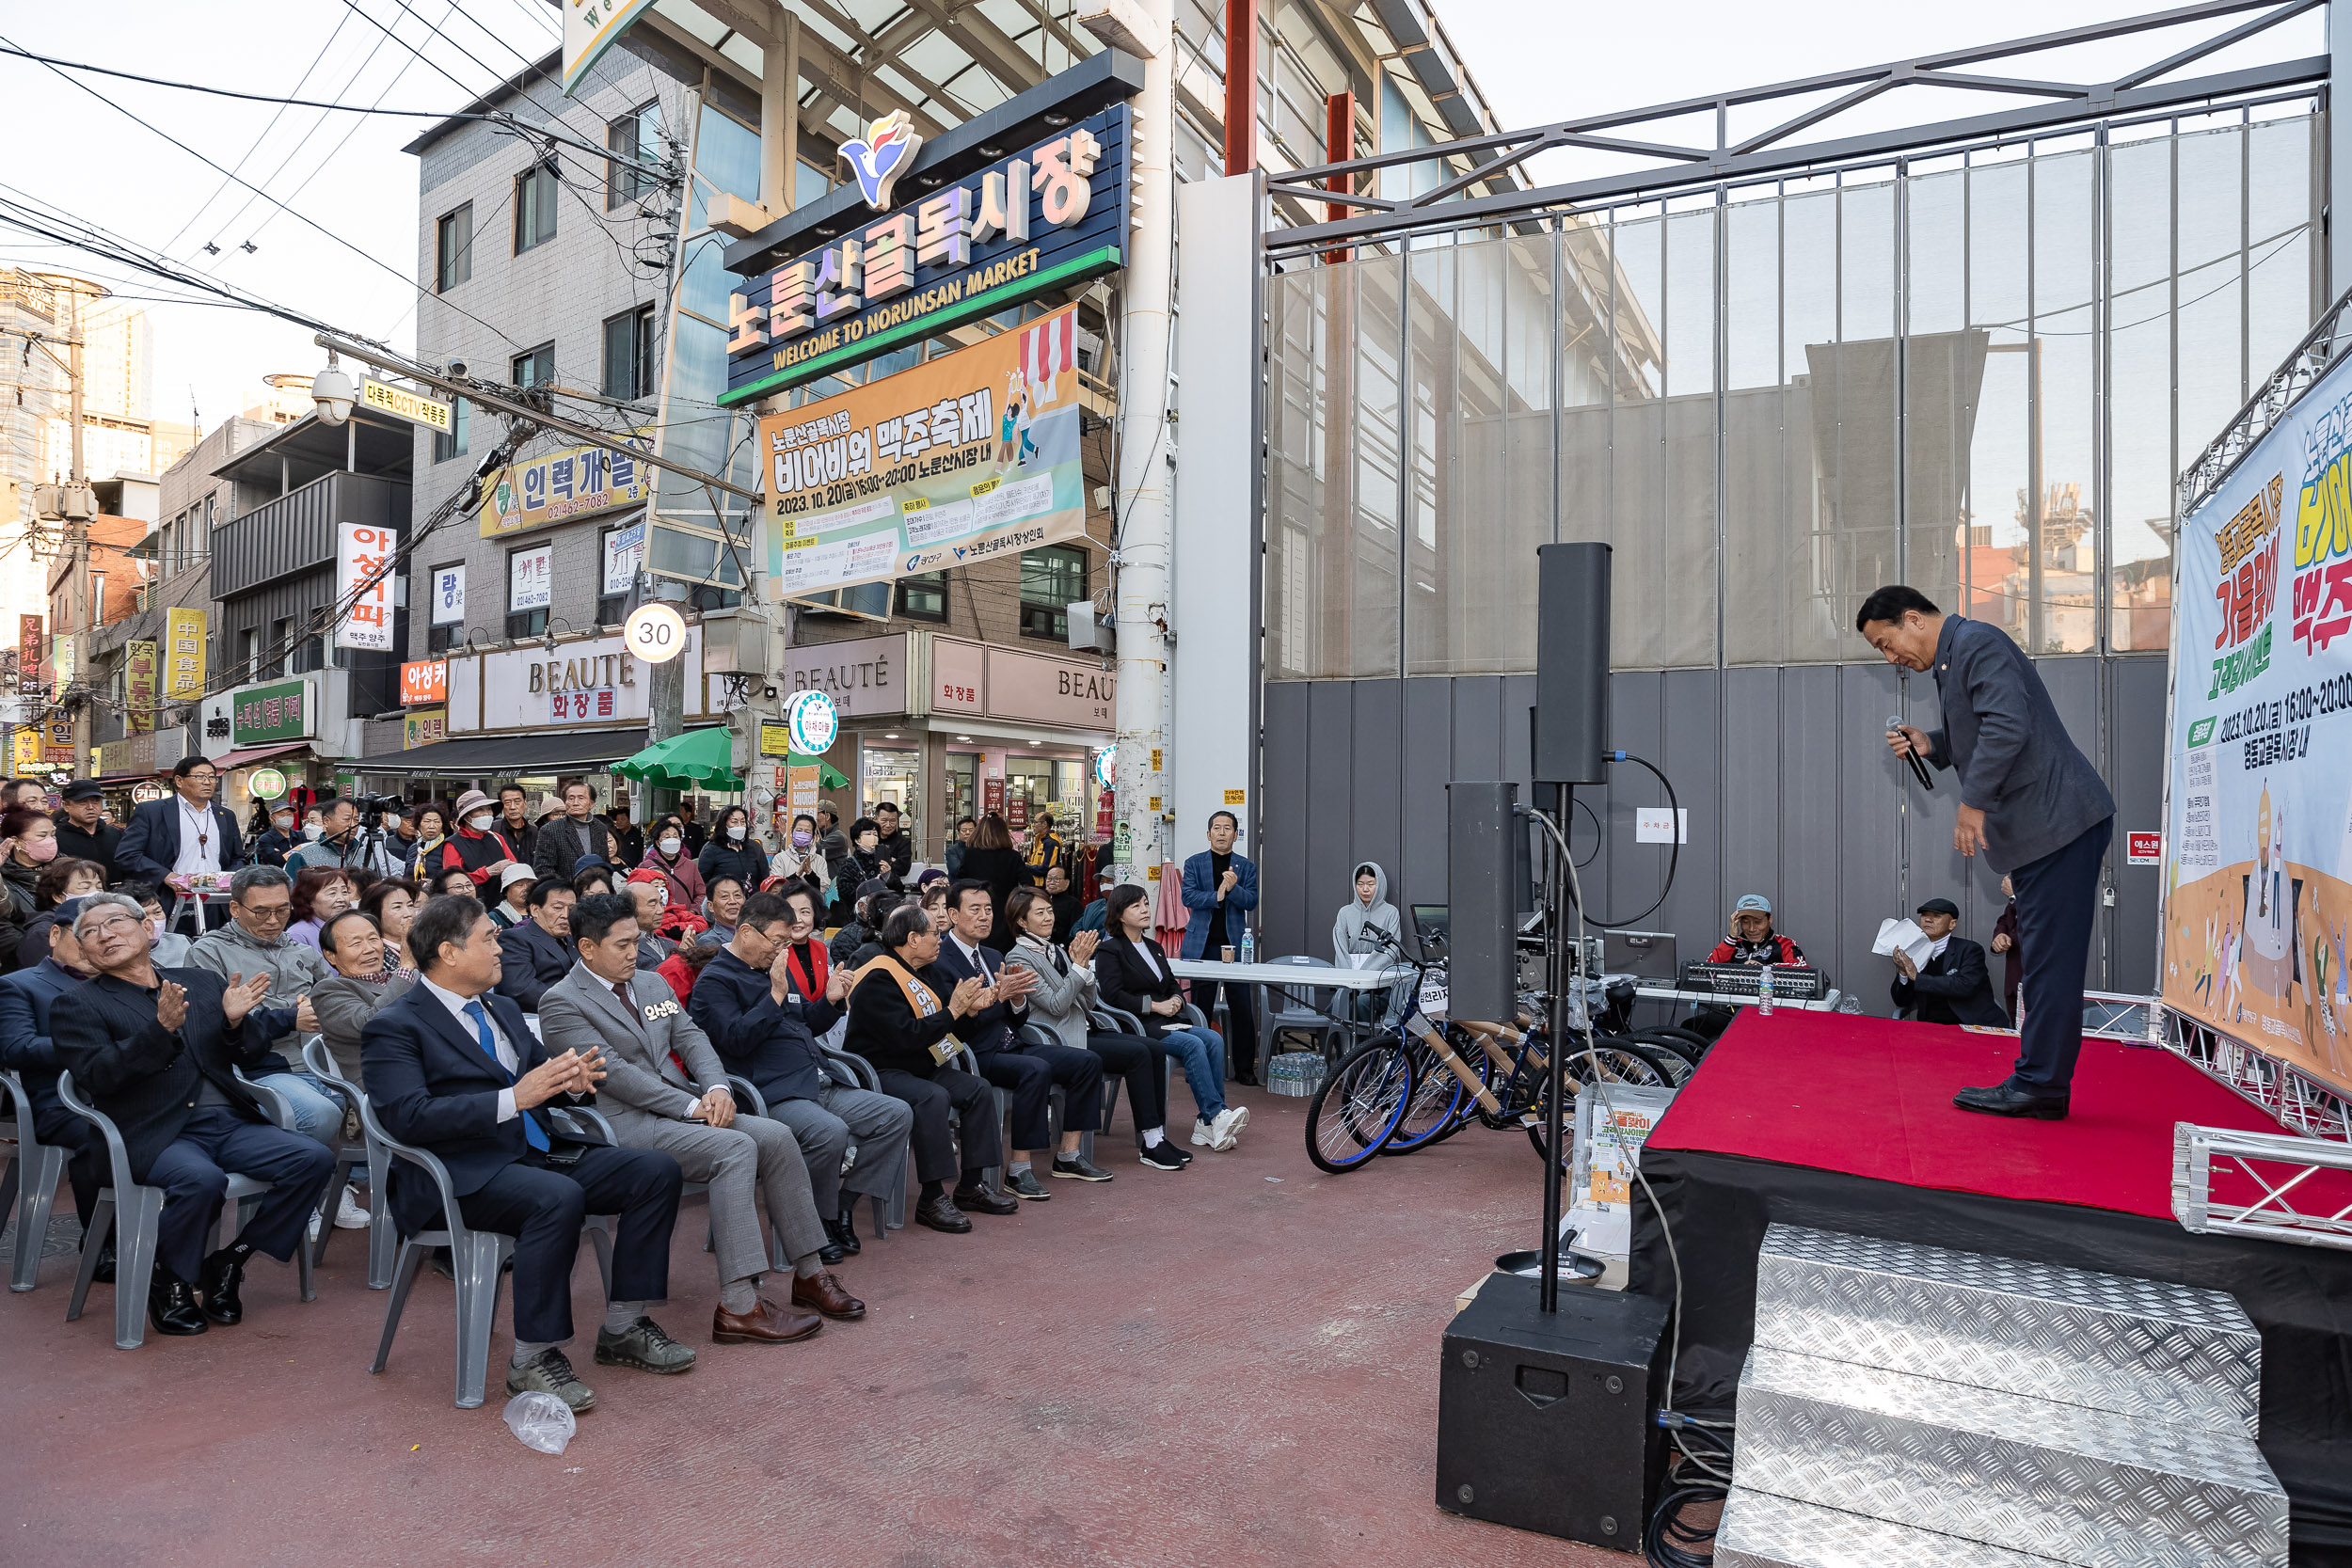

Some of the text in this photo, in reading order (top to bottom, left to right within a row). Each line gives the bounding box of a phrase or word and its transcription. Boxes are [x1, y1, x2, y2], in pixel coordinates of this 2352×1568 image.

[726, 129, 1102, 356] 노룬산골목시장
[28, 295, 45, 313] 500
[773, 247, 1040, 372] WELCOME TO NORUNSAN MARKET
[771, 409, 850, 452] 노룬산골목시장
[773, 387, 993, 494] 비어비워 맥주축제
[918, 446, 978, 480] 노룬산시장
[980, 442, 992, 462] 내
[548, 495, 610, 519] 02)462-7082
[353, 529, 389, 627] 아성커피
[2215, 527, 2280, 649] 가을맞이
[638, 622, 671, 645] 30
[176, 621, 199, 689] 中国食品
[23, 681, 37, 691] 2F
[944, 684, 975, 703] 화장품
[284, 694, 302, 723] 카페
[553, 691, 613, 719] 화장품
[2245, 728, 2298, 770] 영동교골목시장
[2298, 724, 2311, 758] 내
[137, 788, 160, 799] 커피
[256, 781, 281, 792] 카페
[2134, 840, 2158, 849] 에스원
